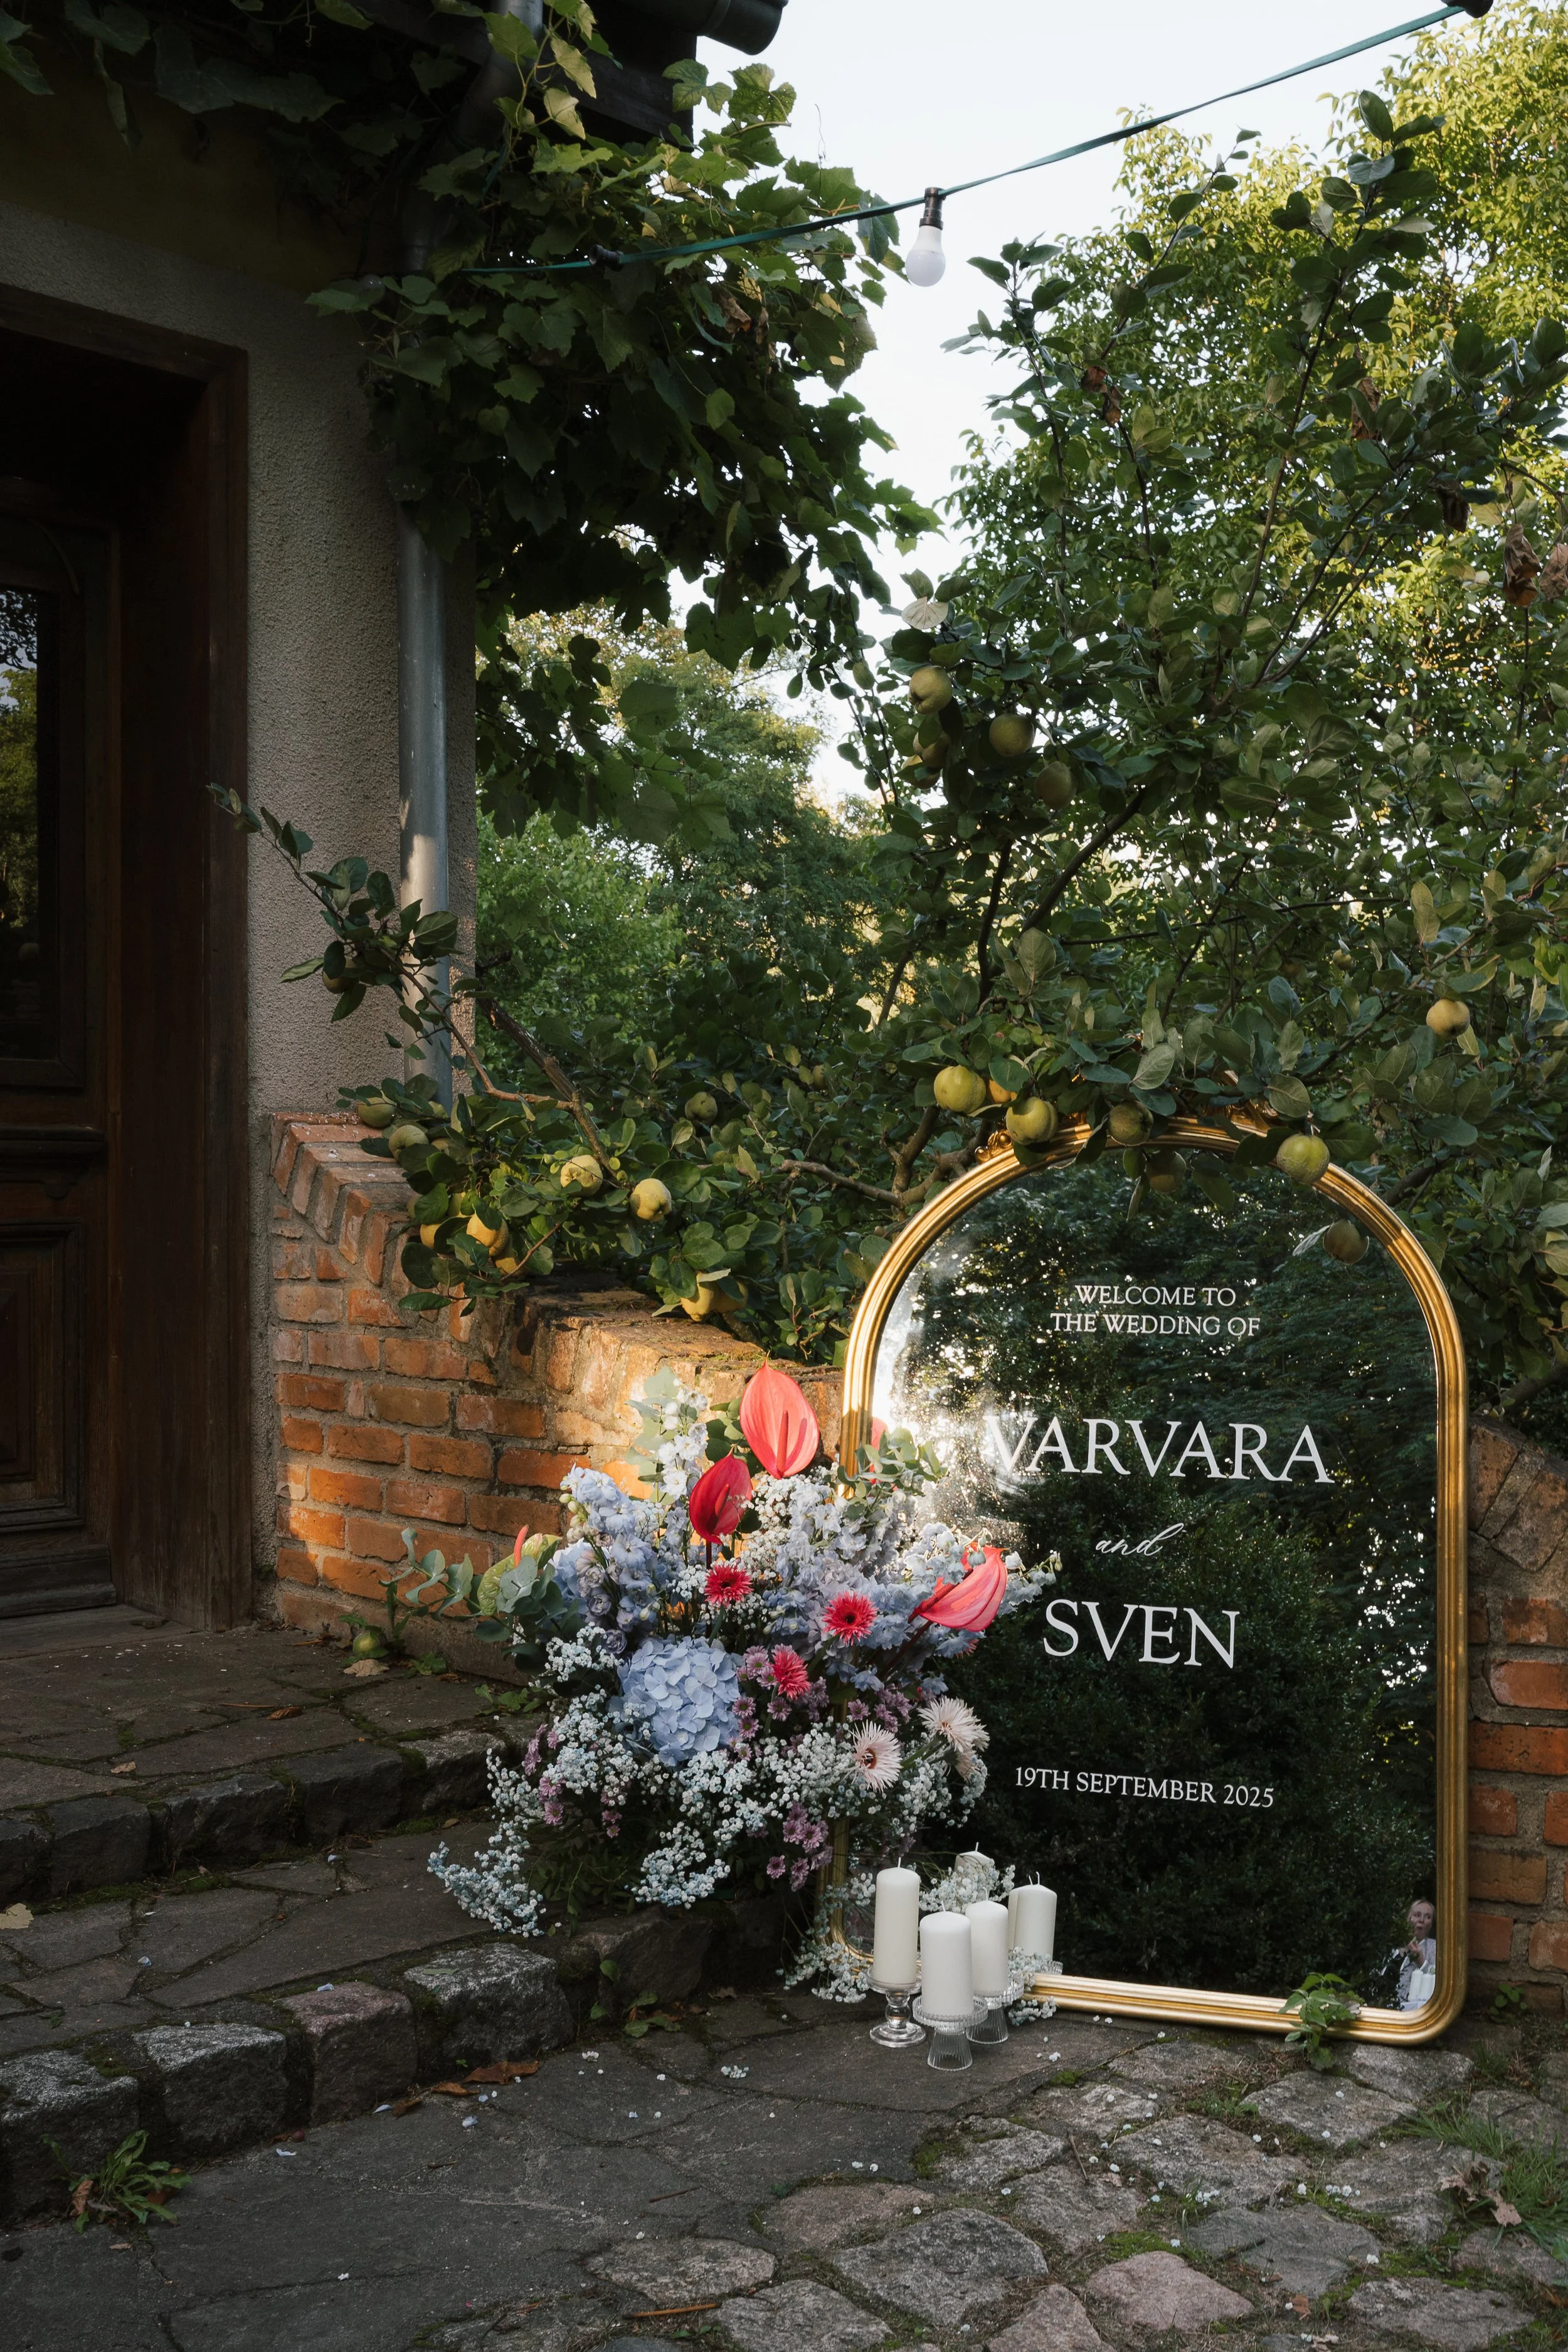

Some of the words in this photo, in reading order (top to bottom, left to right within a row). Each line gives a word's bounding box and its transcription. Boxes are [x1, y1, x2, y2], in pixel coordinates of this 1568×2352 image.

[1075, 1285, 1195, 1306] WELCOME
[1202, 1288, 1236, 1306] TO
[1050, 1313, 1097, 1332] THE
[1104, 1314, 1221, 1335] WEDDING
[1227, 1317, 1260, 1337] OF
[983, 1416, 1335, 1483] VARVARA
[1096, 1523, 1184, 1557] and
[1043, 1599, 1240, 1668] SVEN
[1015, 1767, 1070, 1791] 19TH
[1076, 1772, 1216, 1803] SEPTEMBER
[1223, 1784, 1274, 1808] 2025
